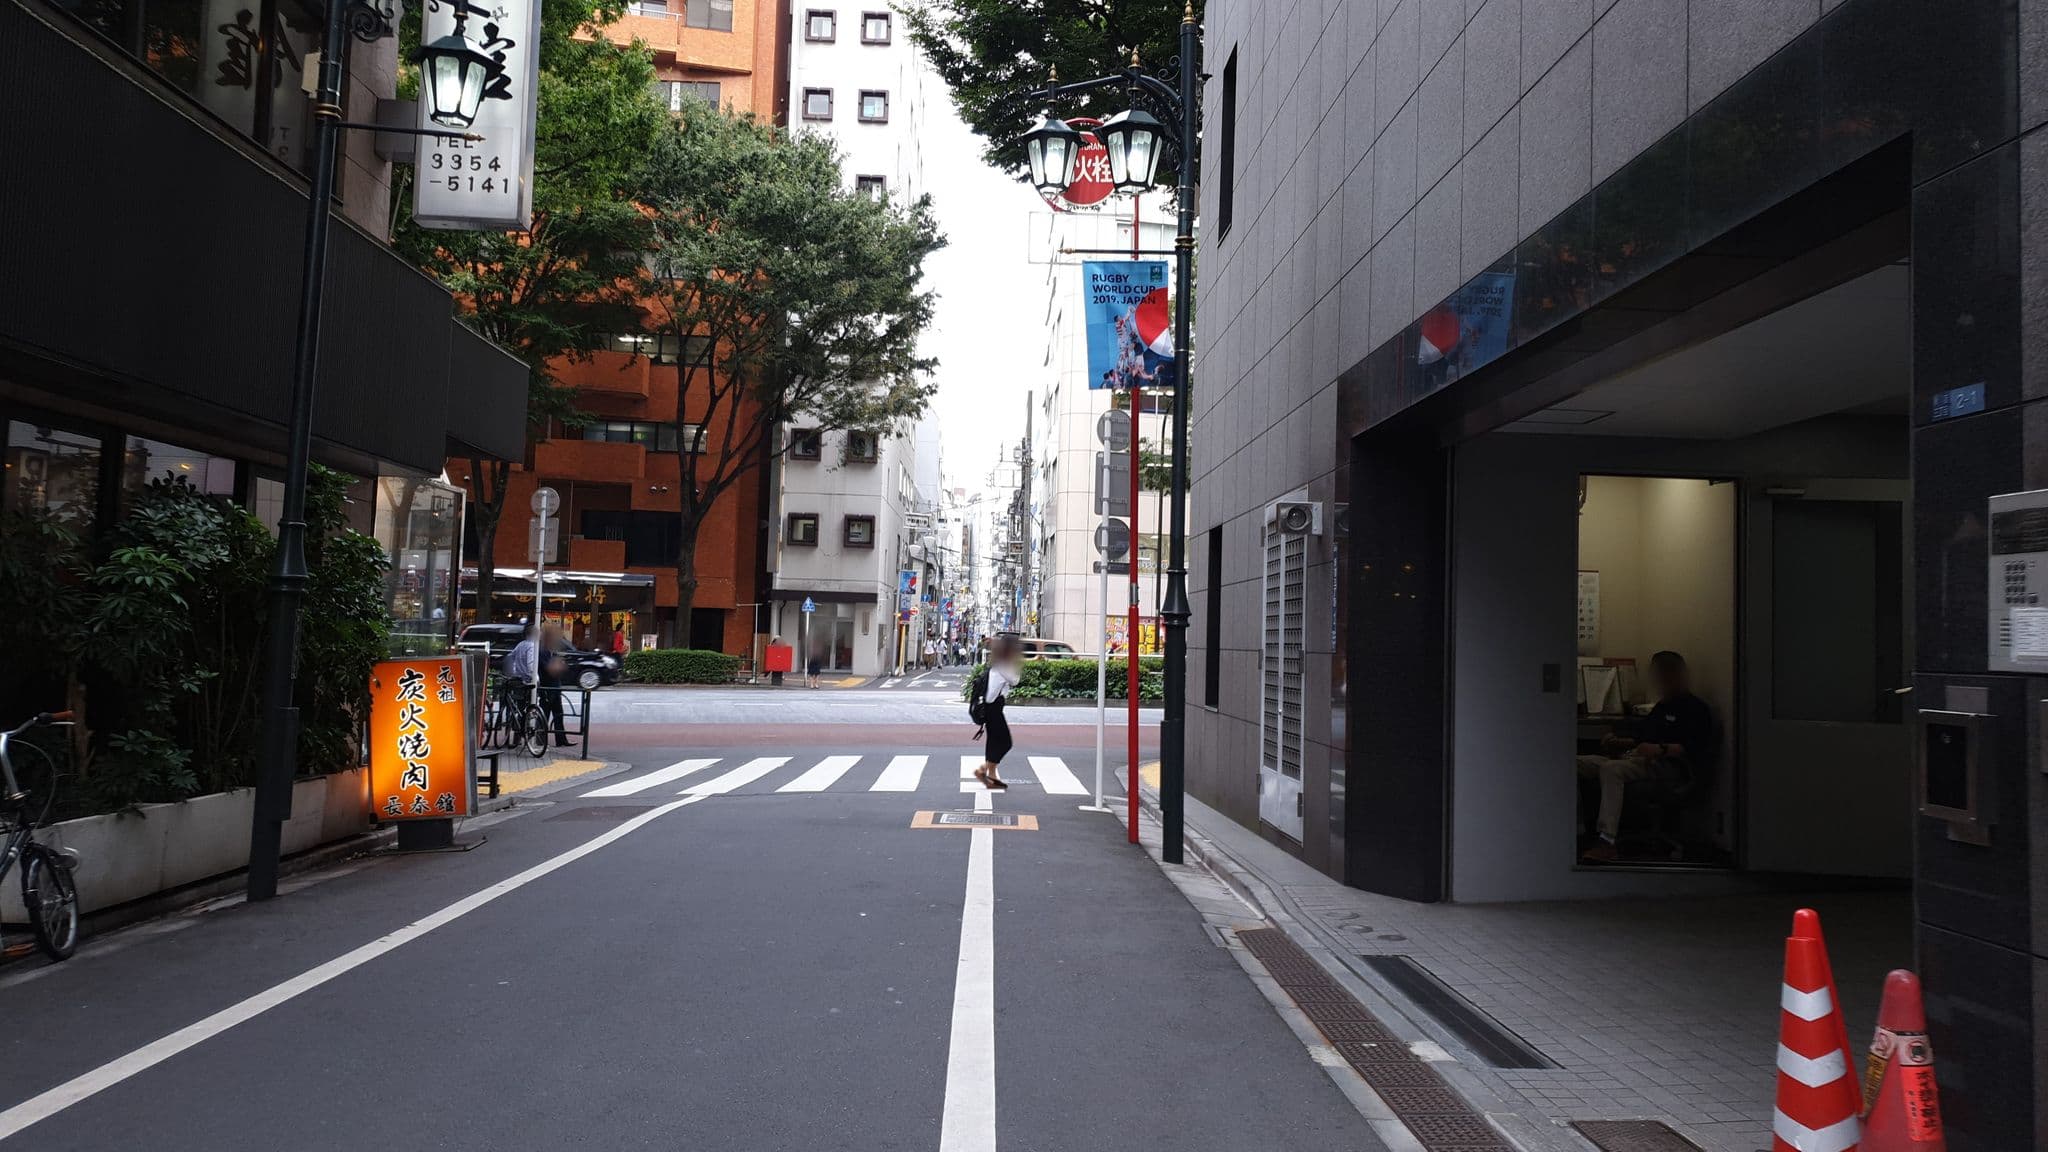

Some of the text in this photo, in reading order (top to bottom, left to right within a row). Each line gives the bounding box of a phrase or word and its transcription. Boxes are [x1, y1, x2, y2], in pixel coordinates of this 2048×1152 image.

[431, 153, 501, 172] 3354
[1072, 155, 1113, 183] 火栓
[429, 176, 509, 194] -5141
[1092, 274, 1129, 283] RUGBY
[1092, 285, 1156, 295] WORLD CUP
[1121, 296, 1156, 305] JAPAN
[436, 666, 457, 703] 元祖
[396, 669, 430, 791] 炭火焼肉
[383, 792, 456, 816] 長春館
